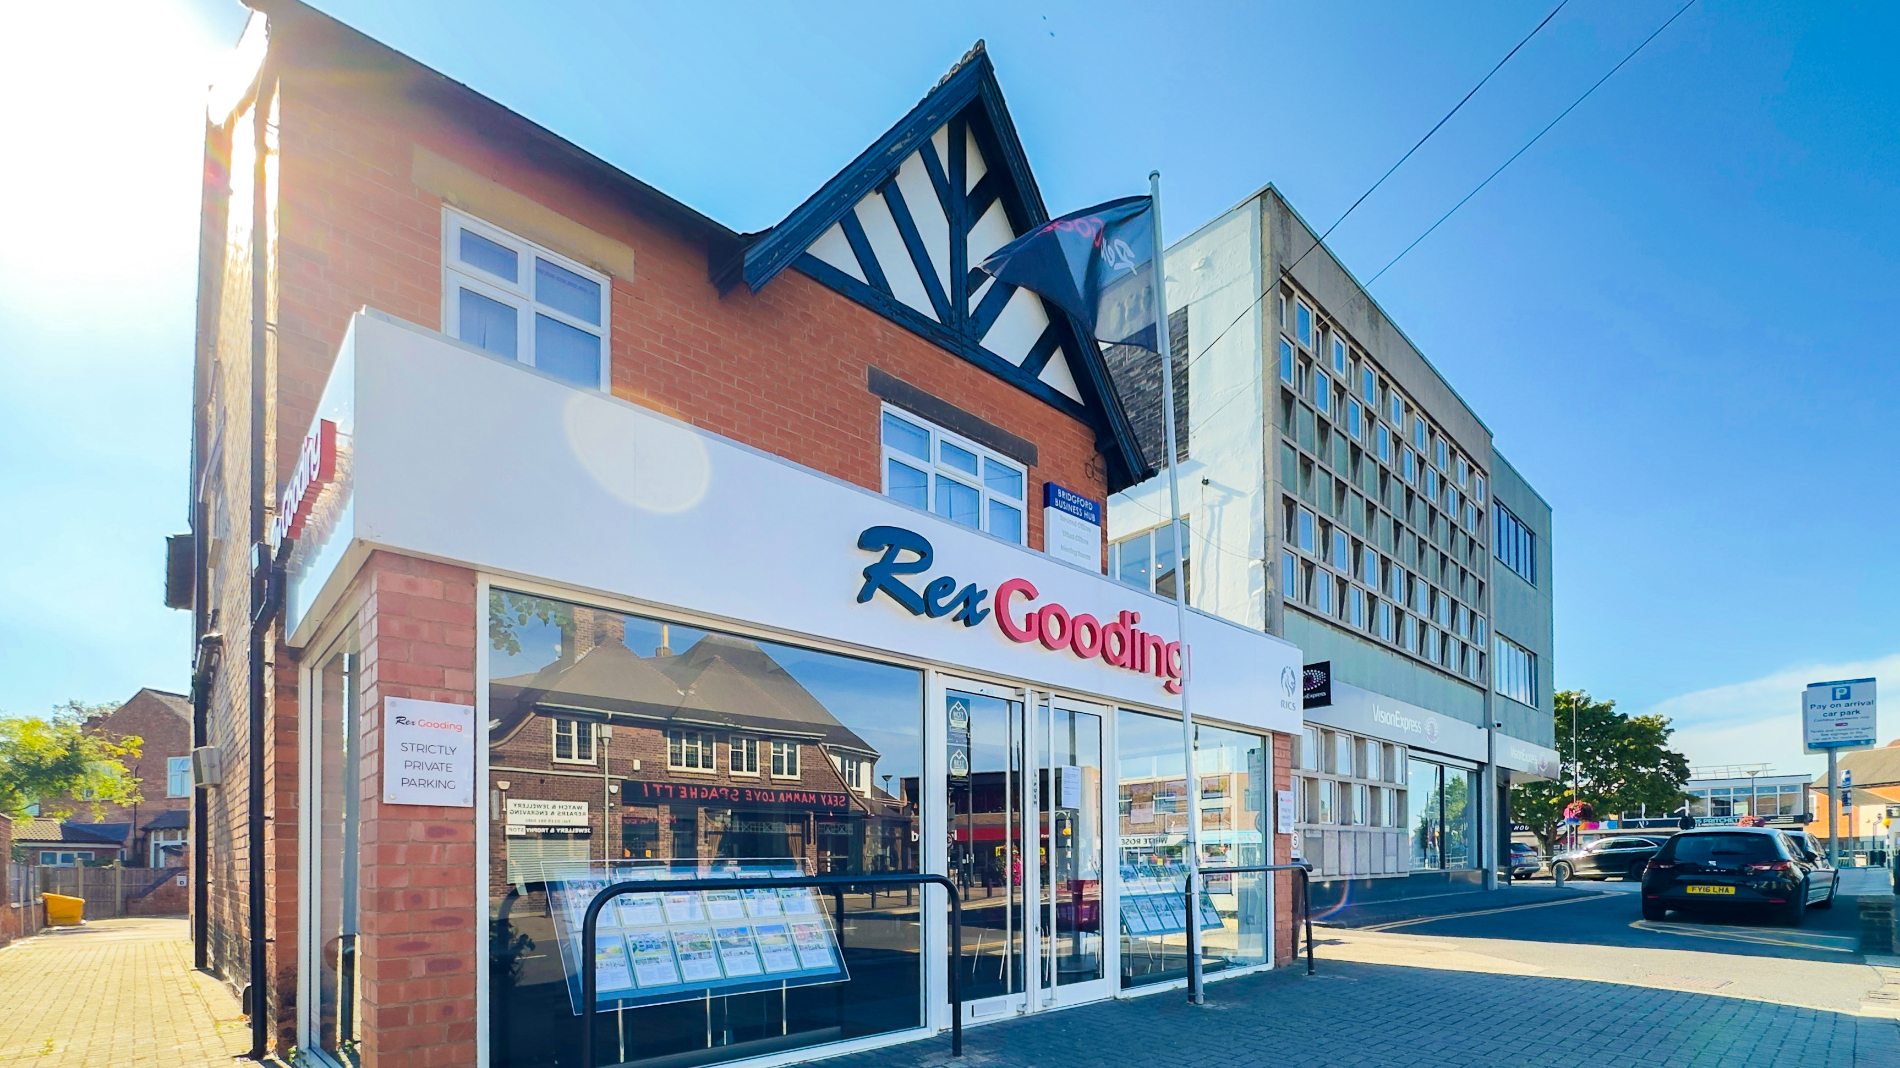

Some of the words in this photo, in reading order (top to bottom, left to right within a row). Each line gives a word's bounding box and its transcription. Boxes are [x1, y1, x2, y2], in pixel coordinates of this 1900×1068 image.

[1057, 489, 1093, 511] BRIDGFORD
[1054, 498, 1082, 516] BUSINESS
[1084, 511, 1096, 522] HUB
[857, 525, 991, 627] Rex
[994, 577, 1191, 695] Gooding
[1281, 700, 1296, 711] RICS
[1844, 700, 1874, 708] arrival
[1372, 703, 1422, 733] VisionExpress
[1840, 709, 1861, 717] park
[395, 716, 415, 726] Rex
[418, 719, 463, 732] Gooding
[400, 742, 457, 755] STRICTLY
[404, 760, 453, 773] PRIVATE
[401, 777, 456, 790] PARKING
[1293, 835, 1298, 846] 5
